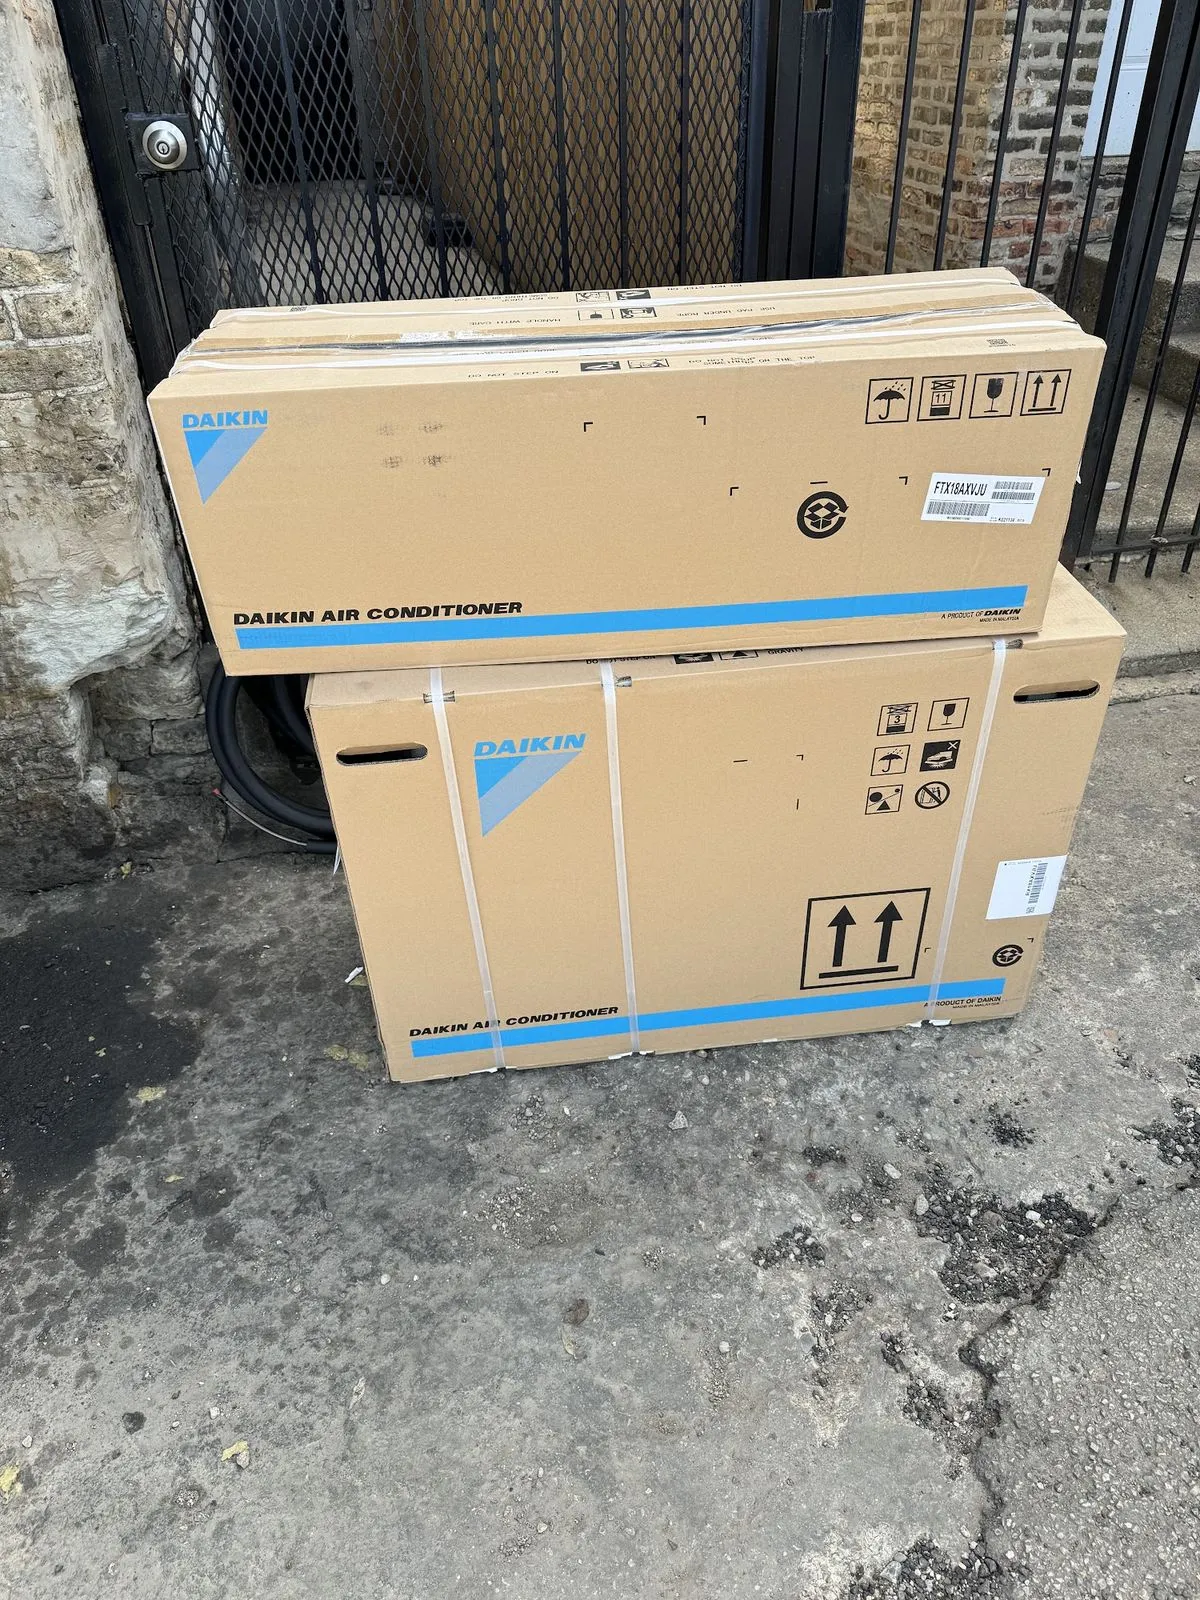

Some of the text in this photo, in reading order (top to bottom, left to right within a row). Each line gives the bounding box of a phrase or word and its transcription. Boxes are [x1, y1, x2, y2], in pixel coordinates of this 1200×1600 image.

[182, 409, 268, 428] DAIKIN
[934, 481, 988, 496] FTX18AXVJU
[234, 602, 523, 625] DAIKIN AIR CONDITIONER
[767, 646, 804, 655] GRAVITY
[894, 715, 901, 724] 3
[474, 733, 586, 756] DAIKIN
[409, 1022, 468, 1036] DAIKIN
[506, 1006, 619, 1026] CONDITIONER
